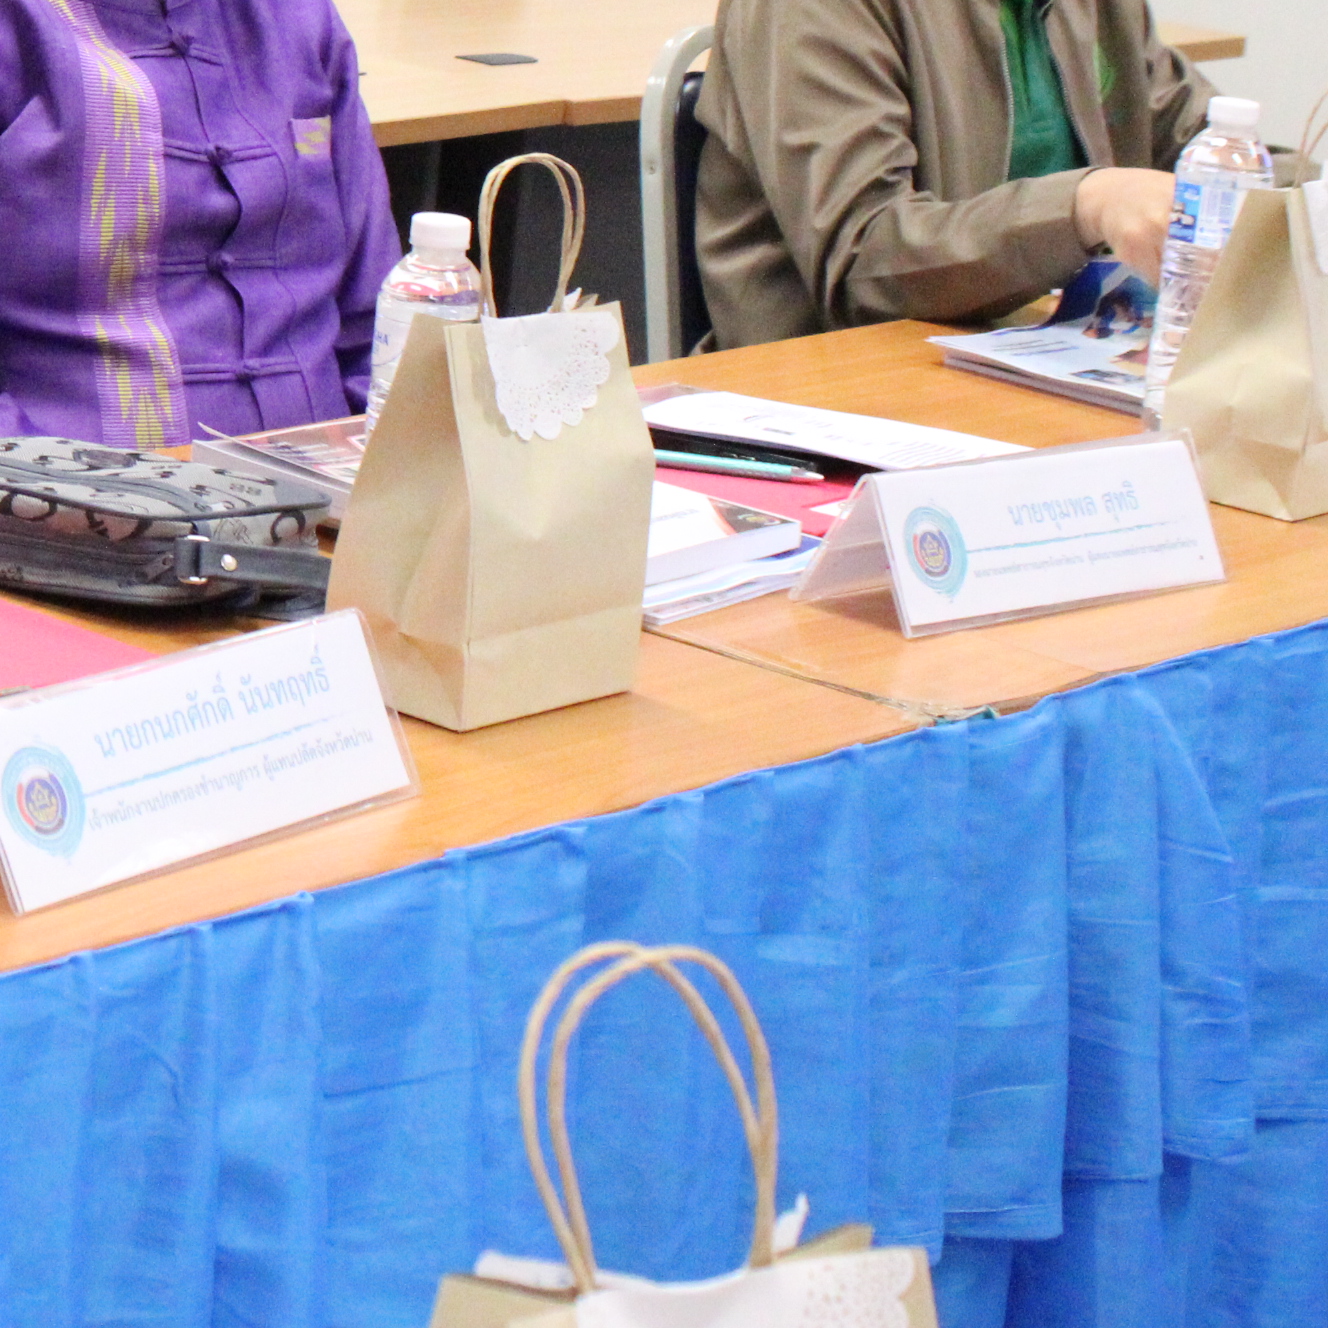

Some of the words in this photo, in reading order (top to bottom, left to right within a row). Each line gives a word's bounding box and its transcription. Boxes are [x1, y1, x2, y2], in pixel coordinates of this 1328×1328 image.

[94, 672, 234, 758] นายกนกศักดิ์
[239, 645, 331, 716] นันทฤทธิ์
